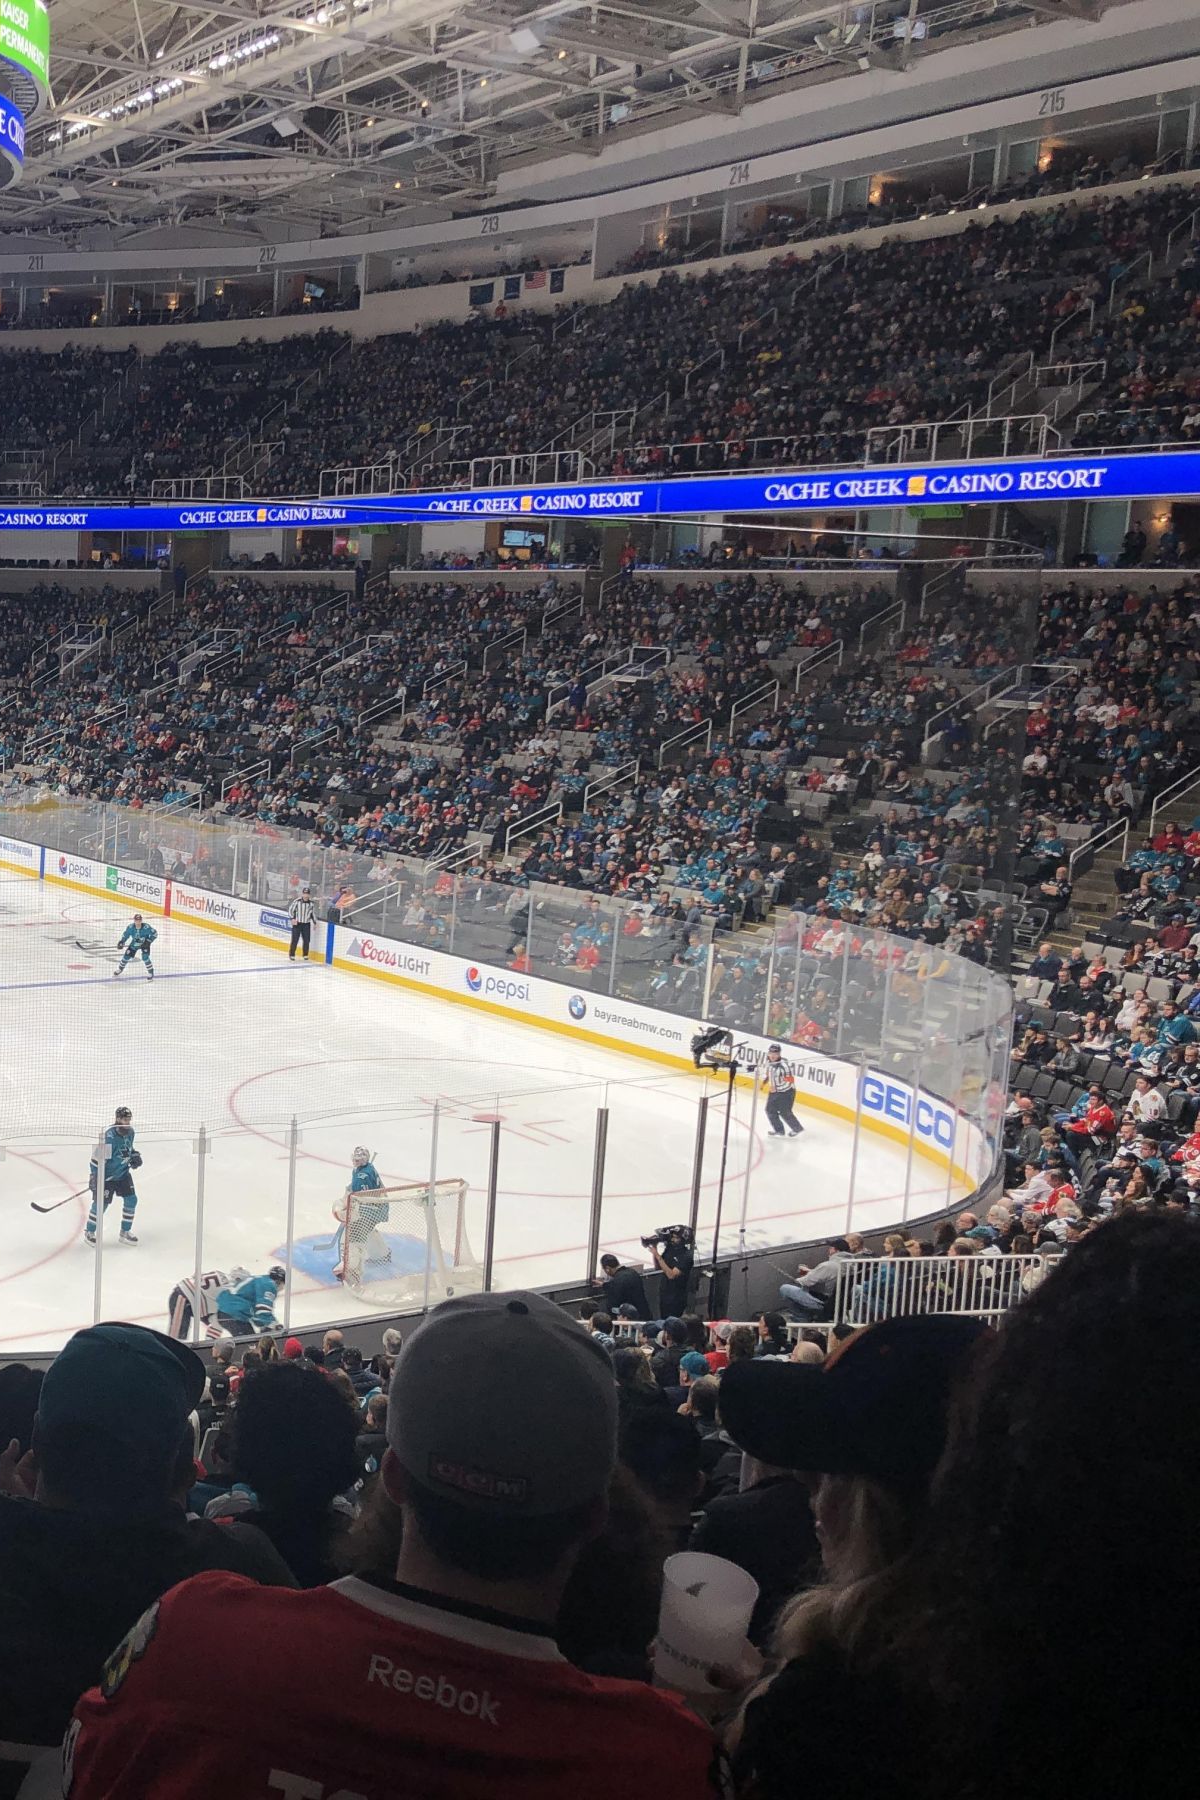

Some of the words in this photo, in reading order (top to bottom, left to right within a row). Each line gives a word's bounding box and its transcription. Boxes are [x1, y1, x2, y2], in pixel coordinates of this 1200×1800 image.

[0, 2, 29, 31] KAISER
[1038, 90, 1066, 116] 215
[729, 164, 751, 186] 214
[480, 215, 499, 234] 213
[27, 254, 45, 271] 211
[259, 246, 277, 264] 212
[764, 482, 831, 502] CACHE
[834, 478, 905, 499] CREEK
[928, 473, 1014, 496] CASINO
[1019, 468, 1107, 490] RESORT
[473, 496, 519, 514] CREEK
[533, 493, 587, 511] CASINO
[591, 490, 644, 508] RESORT
[46, 513, 88, 526] RESORT
[179, 511, 216, 525] CACHE
[218, 509, 255, 524] CREEK
[268, 507, 310, 522] CASINO
[68, 861, 92, 878] pepsi
[110, 872, 161, 897] enterprise
[360, 938, 397, 967] Coors
[397, 952, 431, 976] LIGHT
[485, 976, 530, 1001] pepsi
[593, 1006, 683, 1041] bayareabmw.com
[808, 1066, 837, 1088] NOW
[861, 1076, 955, 1149] GEICO
[367, 1653, 501, 1727] Reebok
